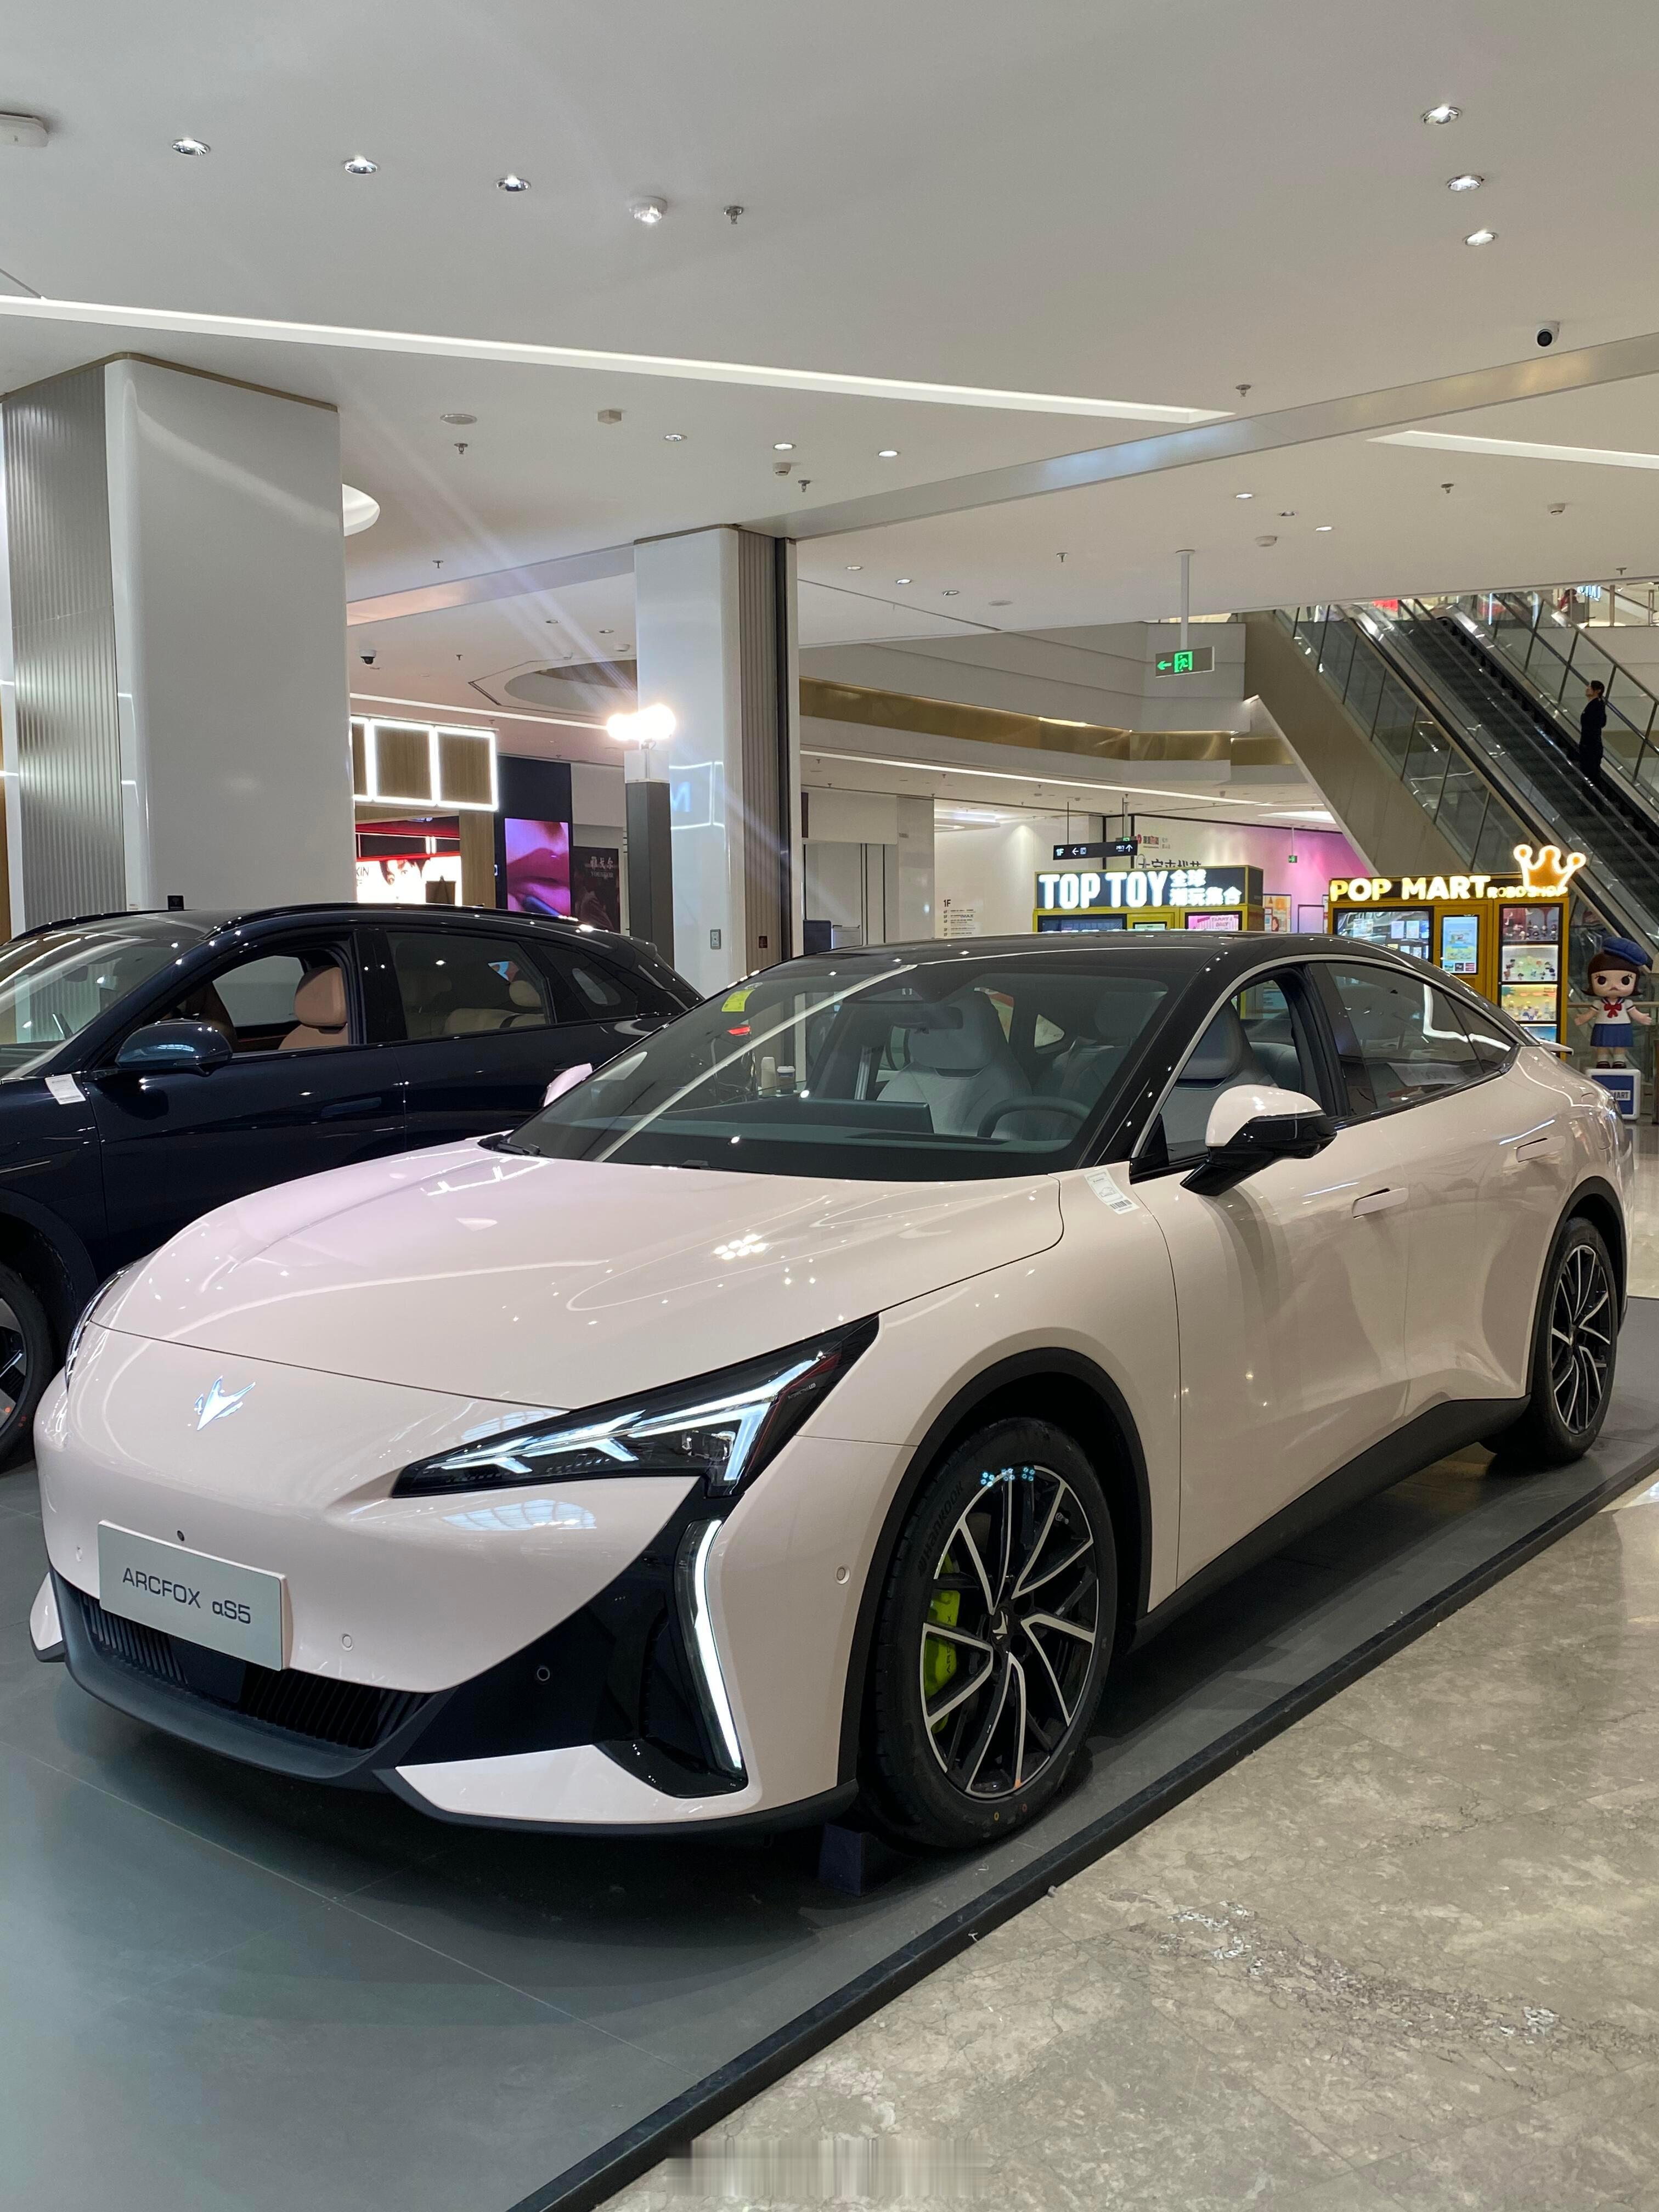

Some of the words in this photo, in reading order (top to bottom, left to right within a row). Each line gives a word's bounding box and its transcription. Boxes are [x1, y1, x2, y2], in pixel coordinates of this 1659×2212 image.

[1039, 873, 1101, 910] TOP
[1105, 871, 1169, 908] TOY
[1170, 869, 1206, 887] 全球
[1330, 878, 1392, 901] POP
[1401, 876, 1491, 900] MART
[1169, 886, 1242, 906] 潮玩集合
[122, 1567, 201, 1609] ARCFOX
